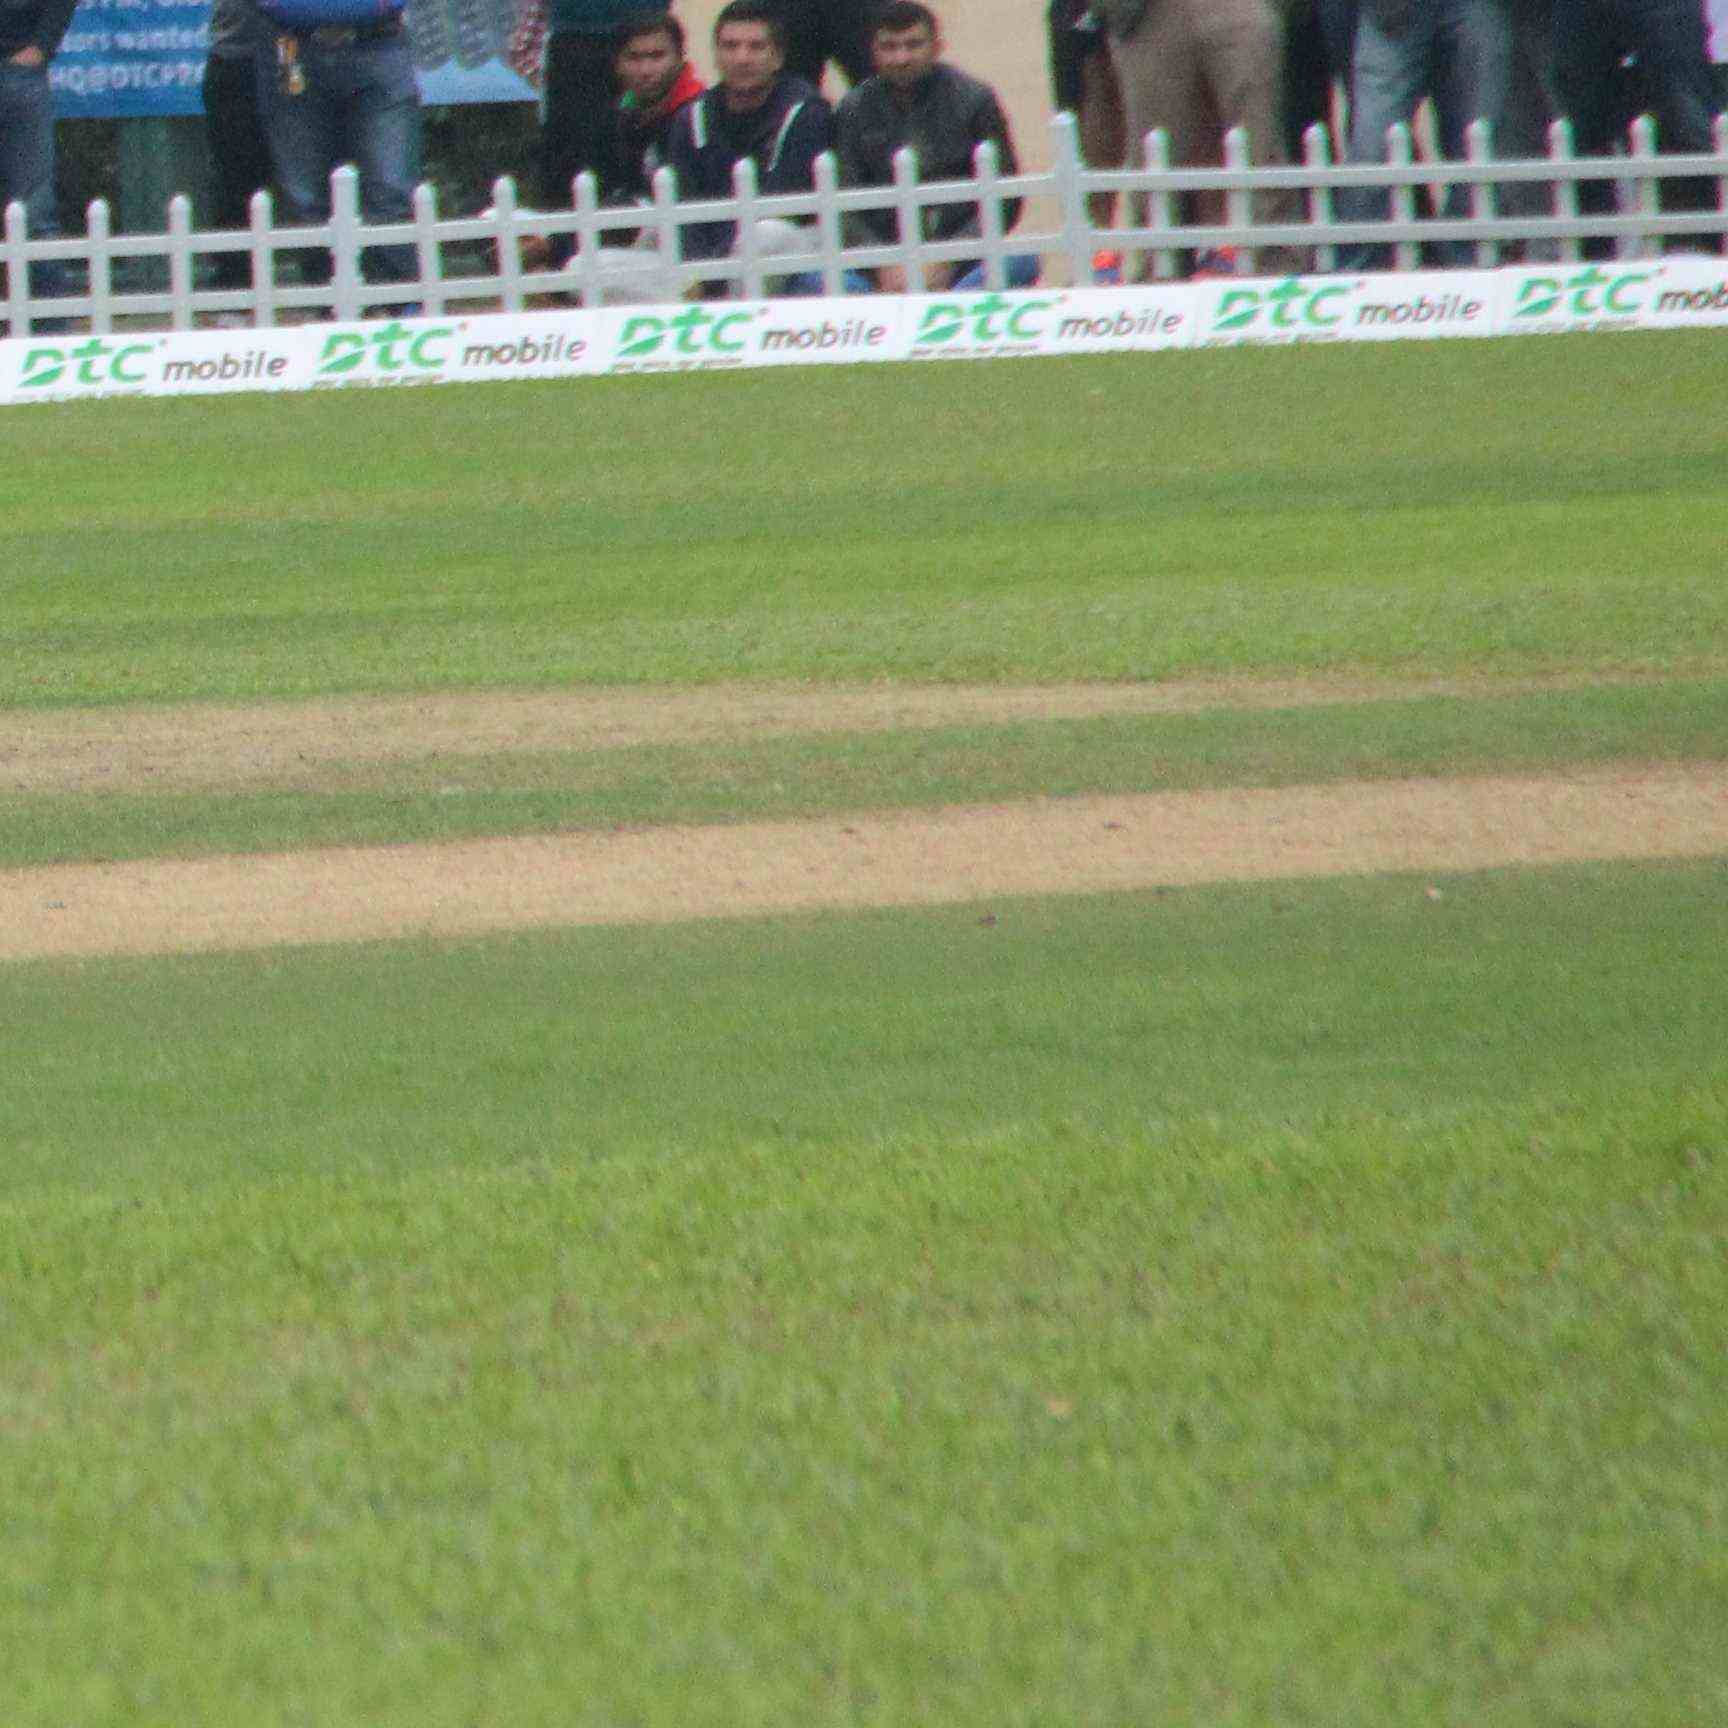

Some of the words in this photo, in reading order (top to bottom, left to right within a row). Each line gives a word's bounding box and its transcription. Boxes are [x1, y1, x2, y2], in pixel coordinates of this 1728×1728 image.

[1058, 307, 1185, 340] mobile
[1357, 292, 1481, 325] mobile
[460, 333, 588, 368] mobile
[761, 319, 887, 352] mobile
[161, 348, 290, 382] mobile
